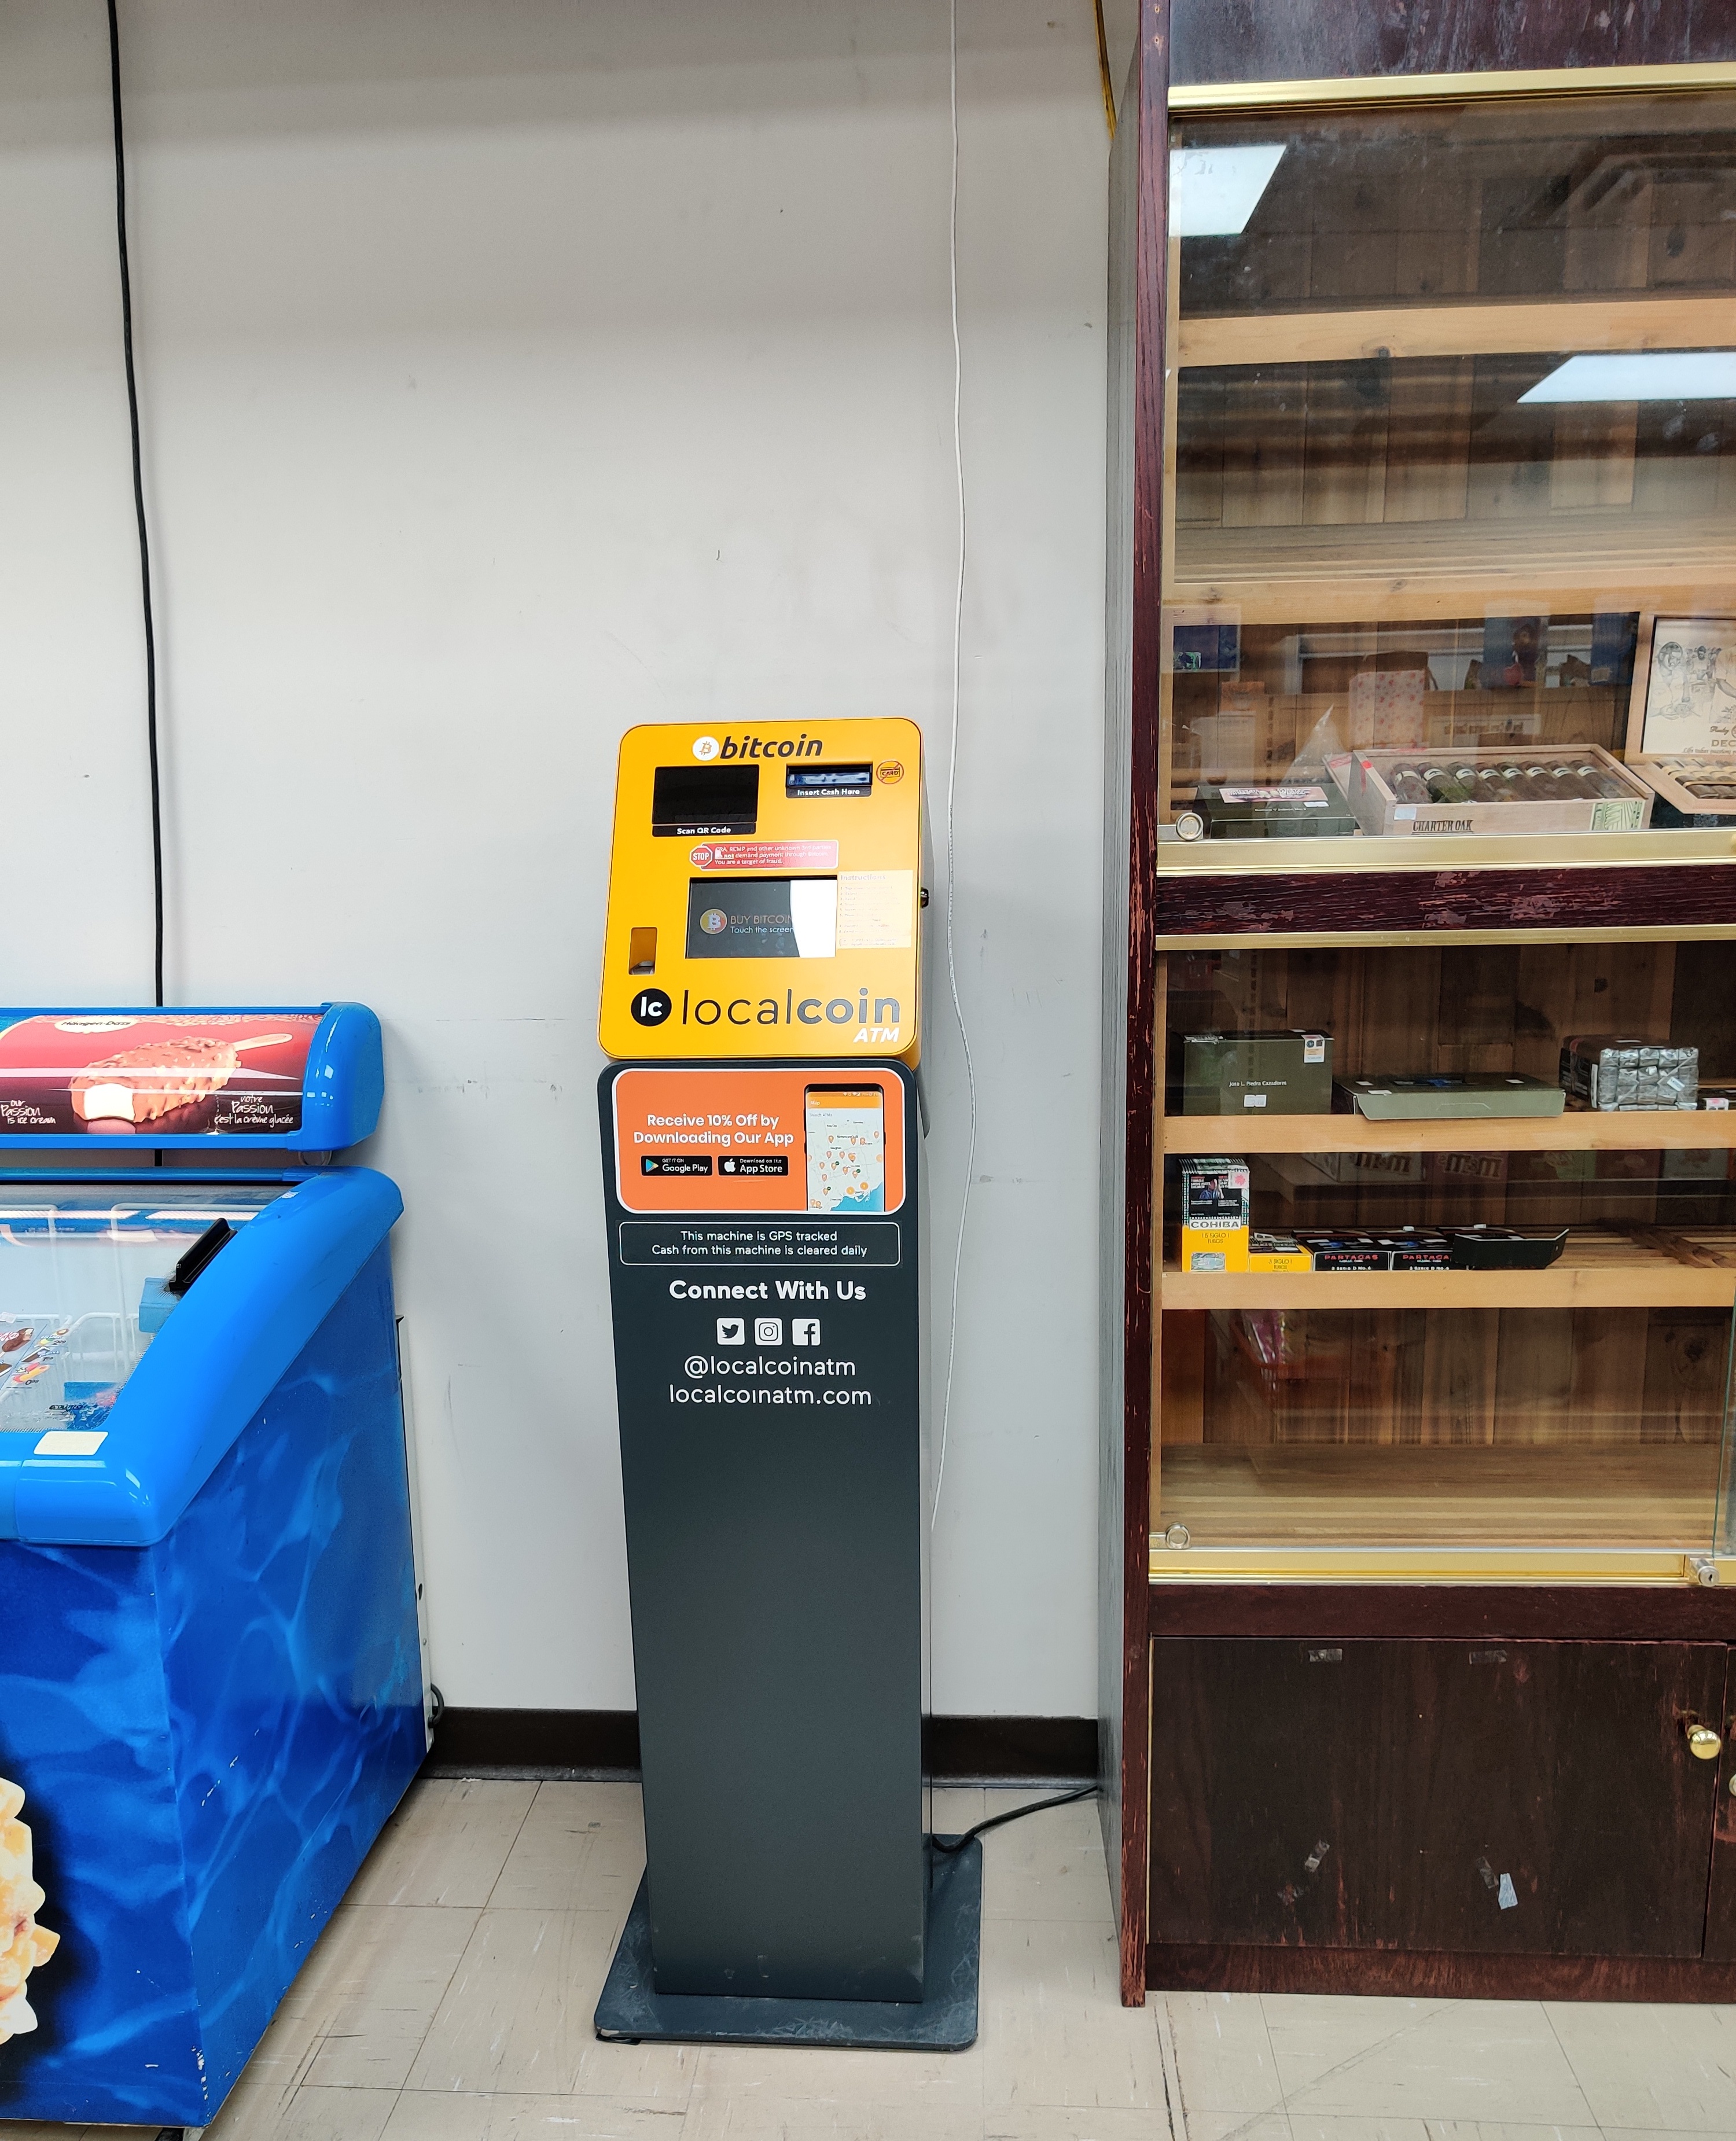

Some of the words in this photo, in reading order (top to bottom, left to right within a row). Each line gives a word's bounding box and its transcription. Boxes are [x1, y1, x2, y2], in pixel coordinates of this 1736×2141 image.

[719, 733, 823, 759] bitcoin
[841, 788, 860, 796] Here
[710, 826, 731, 834] Code
[1413, 820, 1454, 832] CHARTER
[1455, 819, 1474, 831] OAK
[693, 852, 709, 860] STOP
[730, 915, 751, 925] BUY
[682, 987, 900, 1025] localcoin
[852, 1027, 900, 1043] ATM
[240, 1094, 263, 1103] notre
[0, 1104, 41, 1117] Passion
[231, 1100, 274, 1114] Passion
[7, 1116, 16, 1124] is
[17, 1115, 28, 1124] ice
[30, 1116, 57, 1124] cream
[234, 1113, 242, 1124] la
[243, 1114, 268, 1124] crème
[269, 1113, 294, 1128] glacée
[647, 1113, 705, 1127] Receive
[706, 1114, 733, 1127] 10%
[735, 1113, 758, 1127] Off
[760, 1113, 779, 1130] by
[633, 1131, 731, 1147] Downloading
[734, 1132, 762, 1144] Our
[764, 1132, 795, 1147] App
[662, 1164, 692, 1174] Google
[692, 1163, 708, 1174] Play
[740, 1164, 759, 1175] App
[759, 1164, 783, 1173] Store
[1190, 1220, 1240, 1228] COHIBA
[680, 1230, 704, 1241] This
[707, 1230, 753, 1241] machine
[756, 1230, 766, 1241] is
[768, 1231, 793, 1241] GPS
[796, 1231, 838, 1241] tracked
[651, 1245, 679, 1255] Cash
[682, 1245, 708, 1255] from
[711, 1245, 731, 1255] this
[734, 1245, 781, 1255] machine
[784, 1245, 794, 1255] is
[797, 1245, 838, 1256] cleared
[841, 1245, 867, 1257] daily
[668, 1279, 768, 1300] Connect
[775, 1280, 829, 1301] With
[836, 1281, 867, 1301] Us
[684, 1355, 856, 1379] @localcoinatm
[669, 1384, 872, 1406] localcoinatm.com
